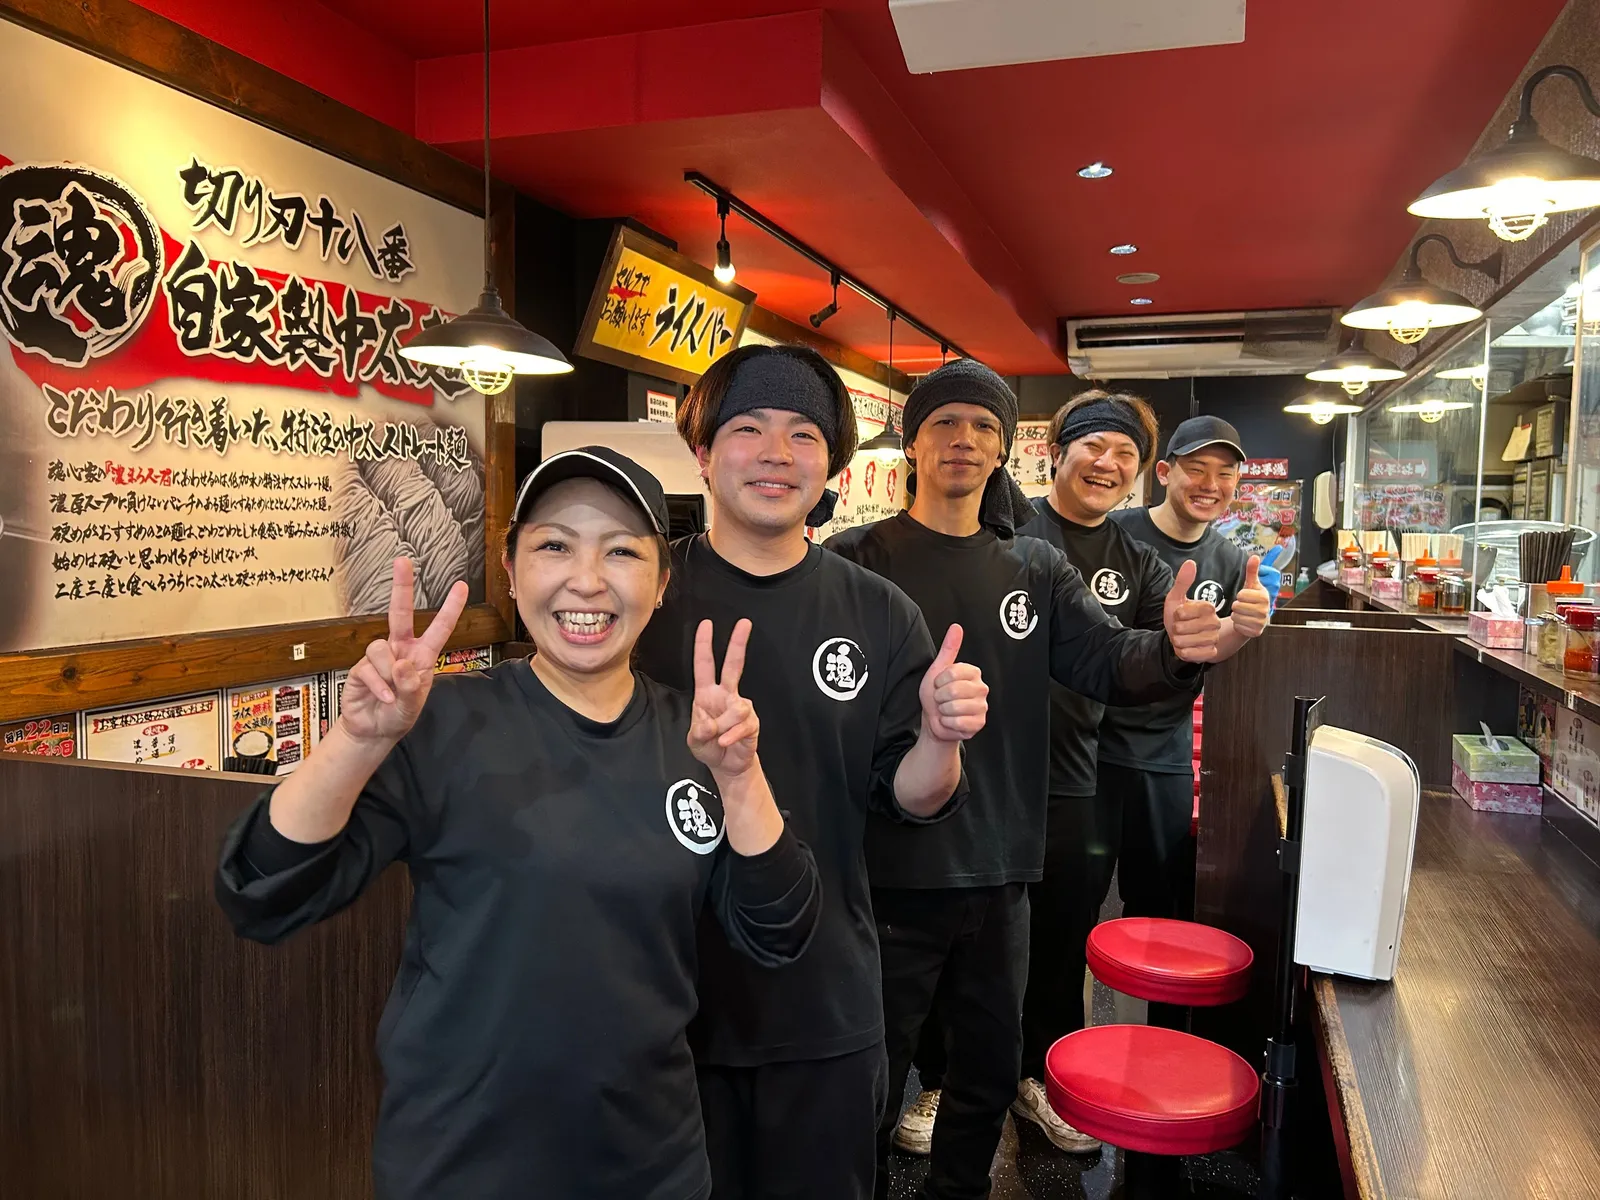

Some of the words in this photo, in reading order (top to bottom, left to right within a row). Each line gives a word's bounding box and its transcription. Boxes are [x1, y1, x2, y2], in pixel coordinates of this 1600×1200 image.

[2, 182, 126, 336] 魂
[179, 156, 415, 280] 切り刃十八番
[648, 287, 732, 358] ライスバー
